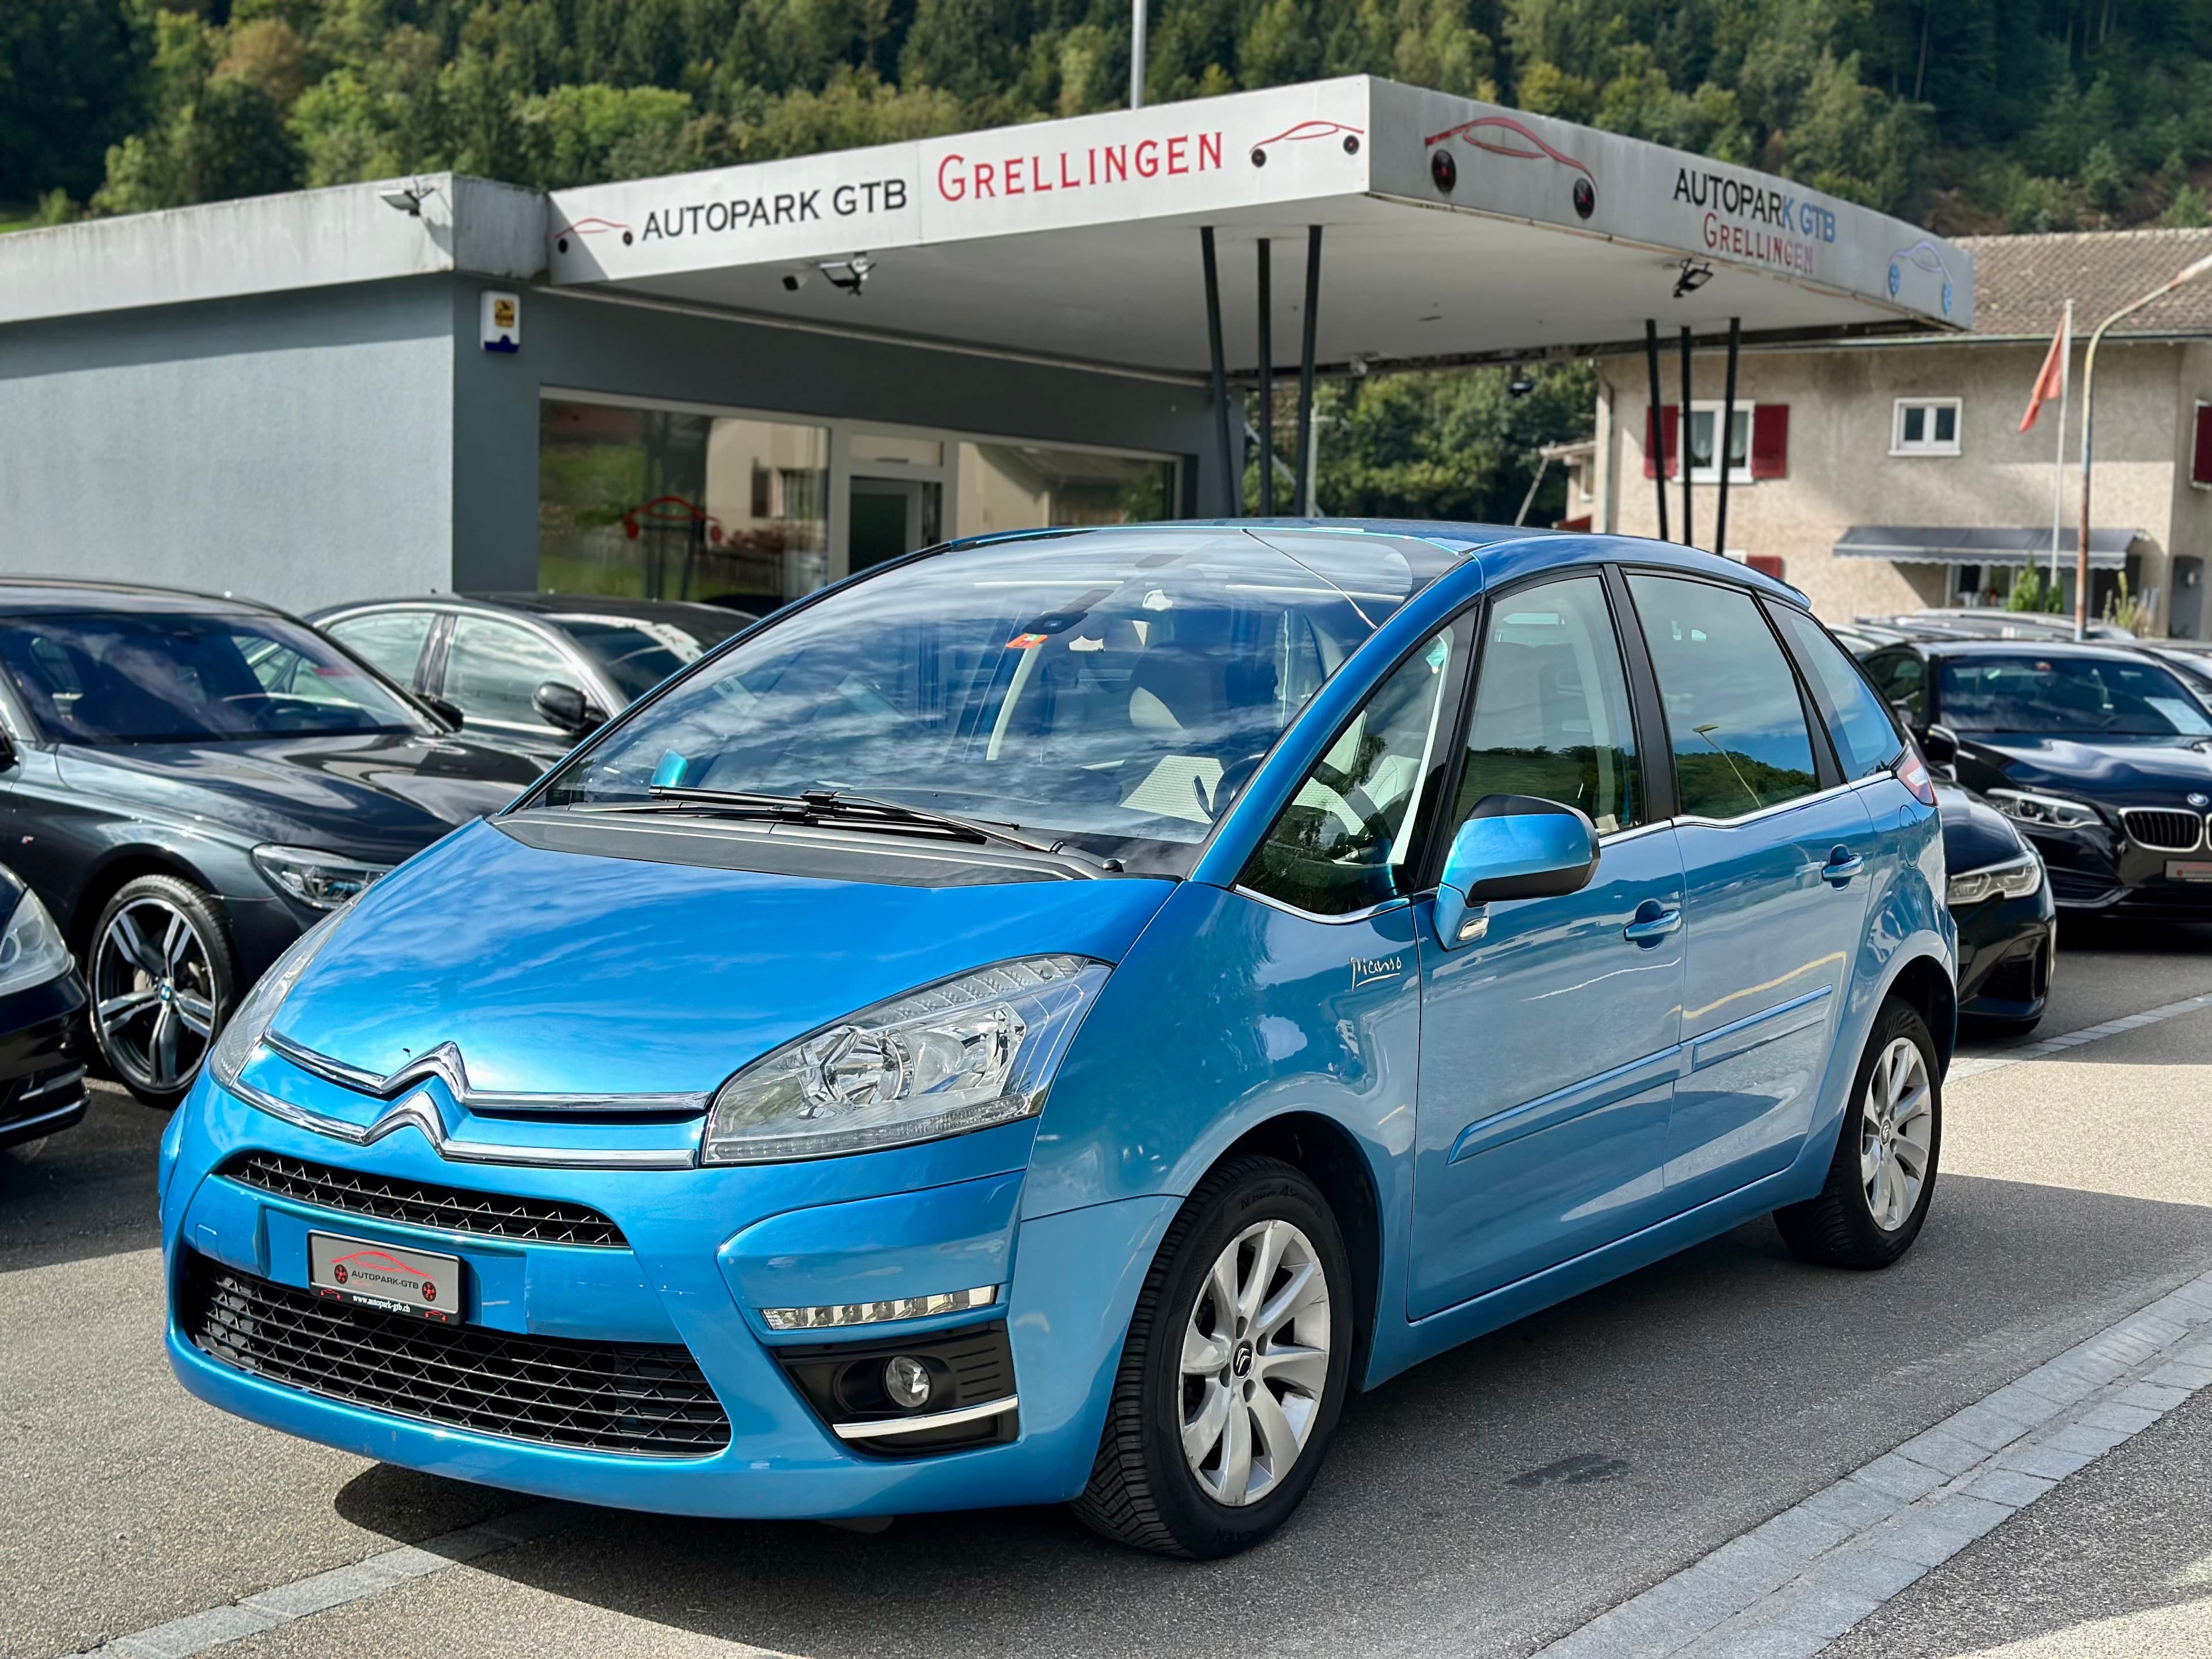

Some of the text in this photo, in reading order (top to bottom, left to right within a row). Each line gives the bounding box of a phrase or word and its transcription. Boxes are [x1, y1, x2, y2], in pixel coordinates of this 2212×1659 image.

[642, 131, 1222, 241] AUTOPARK GTB GRELLINGEN
[1673, 168, 1836, 244] AUTOPARK GTB
[1703, 212, 1813, 274] GRELLINGEN
[351, 1270, 419, 1289] AUTOPARK-GTB
[353, 1295, 411, 1313] www.autopark-gtb.ch
